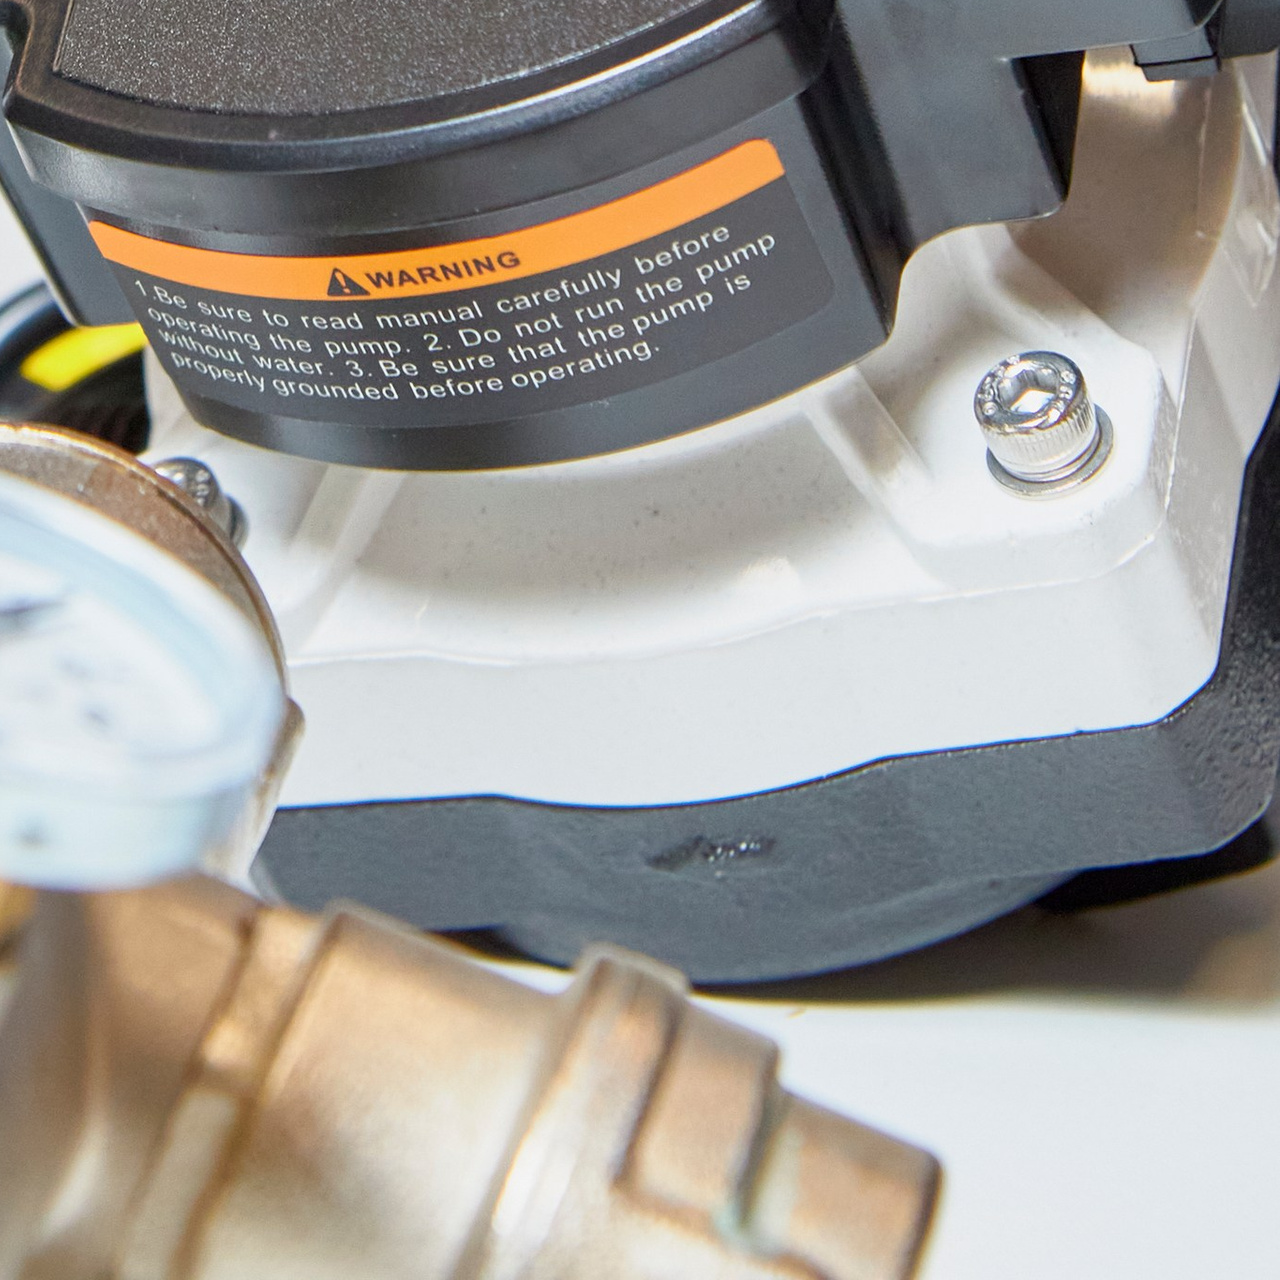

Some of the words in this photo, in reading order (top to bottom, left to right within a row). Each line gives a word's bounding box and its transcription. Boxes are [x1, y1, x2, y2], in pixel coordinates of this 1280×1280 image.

[147, 306, 261, 351] operating
[269, 332, 312, 354] the
[324, 339, 411, 358] pump.
[423, 333, 451, 352] 2.
[458, 328, 501, 348] Do
[514, 312, 564, 338] not
[575, 296, 624, 323] run
[635, 276, 683, 303] the
[696, 233, 776, 285] pump
[196, 299, 252, 324] sure
[262, 308, 289, 328] to
[301, 312, 363, 331] read
[376, 300, 484, 329] manual
[497, 267, 621, 314] carefully
[634, 225, 730, 275] before
[365, 251, 521, 289] WARNING
[158, 328, 244, 365] without
[253, 354, 334, 376] water.
[345, 359, 372, 378] 3.
[379, 359, 419, 378] Be
[434, 353, 496, 375] sure
[508, 336, 567, 365] that
[577, 322, 626, 349] the
[632, 290, 714, 335] pump
[724, 273, 752, 295] is
[170, 350, 266, 392] properly
[272, 378, 399, 401] grounded
[409, 377, 504, 400] before
[511, 340, 660, 389] operating.
